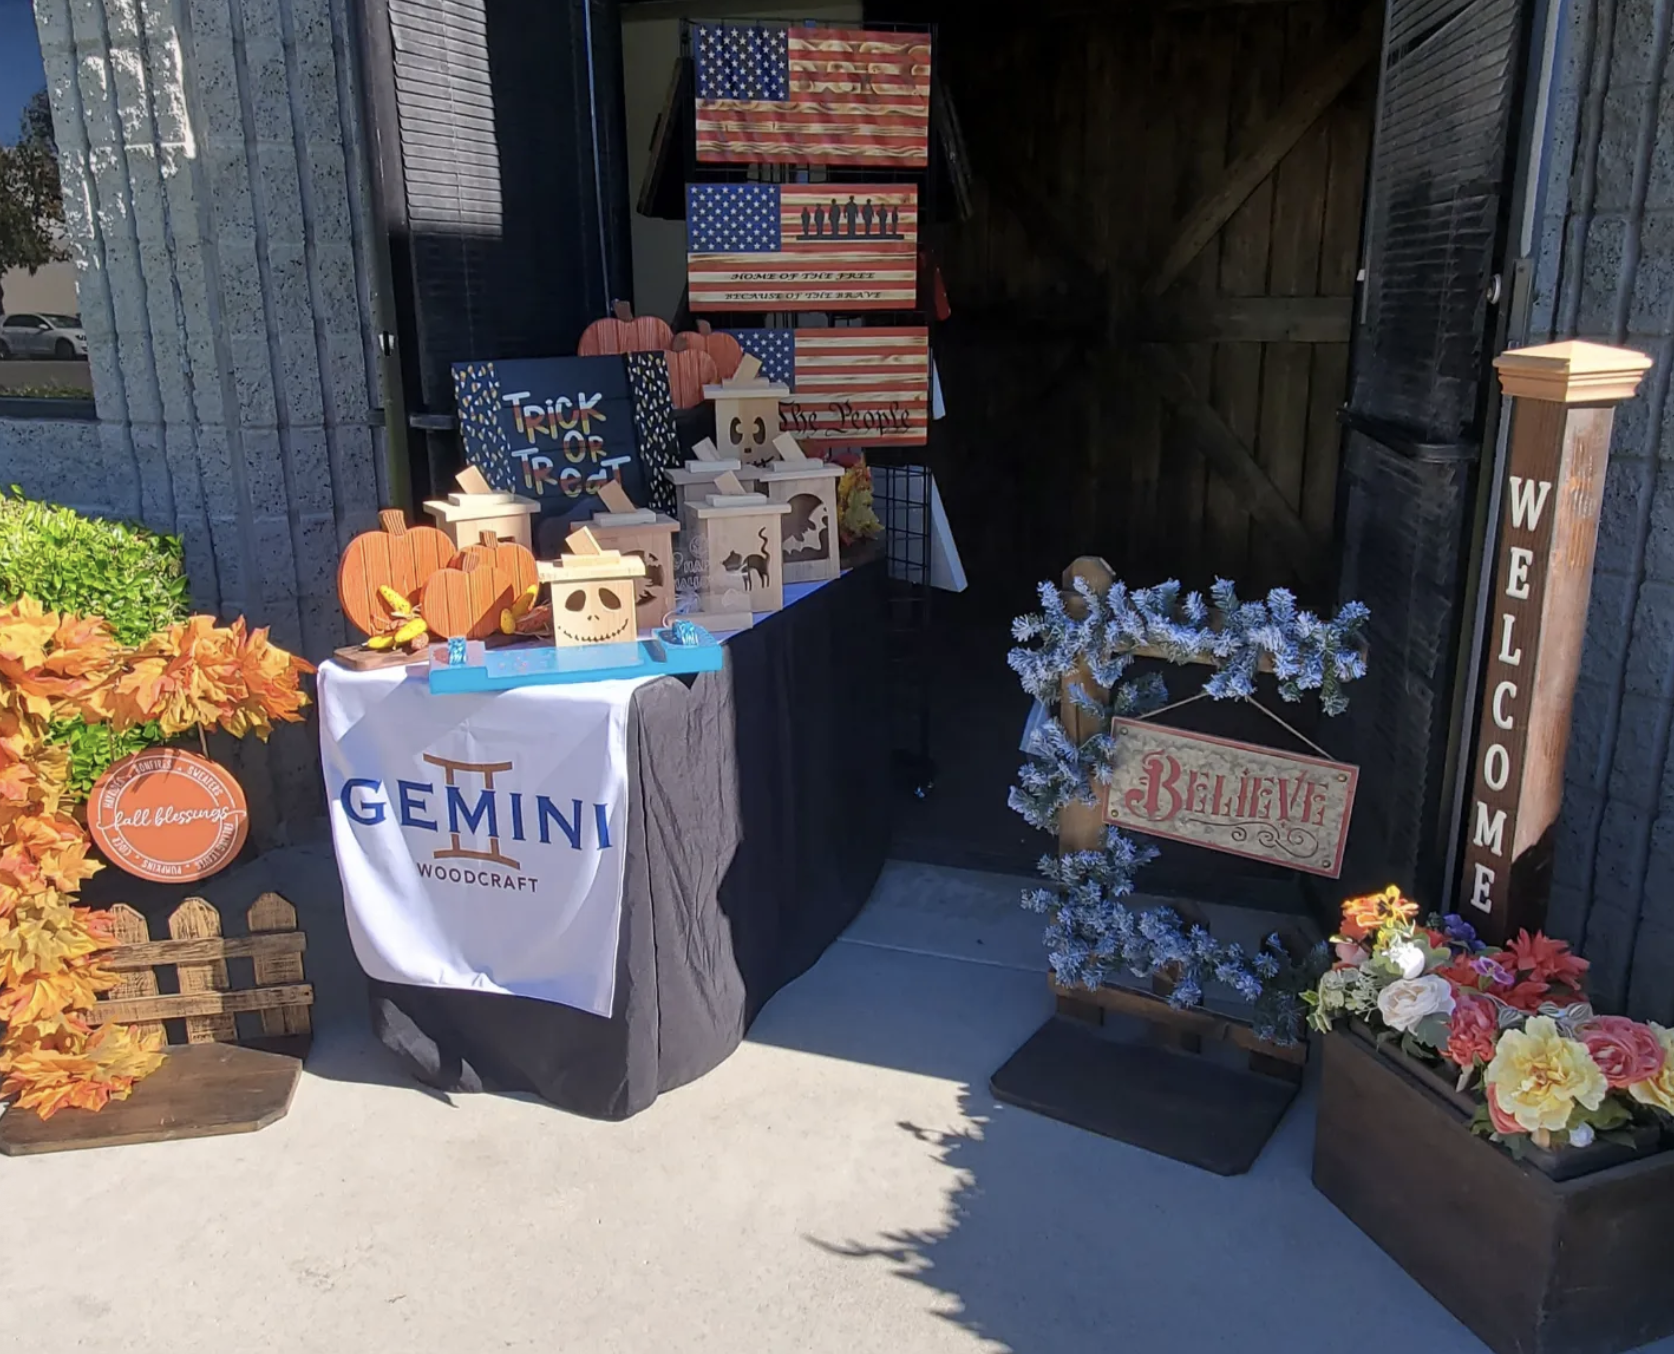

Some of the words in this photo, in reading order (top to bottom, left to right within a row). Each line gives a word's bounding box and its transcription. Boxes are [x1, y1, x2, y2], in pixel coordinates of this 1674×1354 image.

[730, 272, 776, 281] HOME
[779, 272, 799, 281] OF
[801, 272, 834, 280] THE
[835, 272, 876, 281] FREE
[725, 292, 782, 300] BECAUSE
[785, 292, 802, 300] OF
[804, 291, 834, 299] THE
[836, 291, 882, 299] BRAVE
[778, 400, 818, 434] The
[824, 399, 912, 436] People
[563, 430, 607, 463] OR
[1470, 476, 1552, 914] WELCOME
[187, 765, 224, 797] SWEATERS
[1124, 750, 1329, 828] BELIEVE
[113, 808, 151, 831] fall
[154, 805, 230, 827] blessings
[340, 778, 613, 850] GEMINI
[141, 860, 182, 875] PUMPKINS
[415, 862, 539, 893] WOODCRAFT
